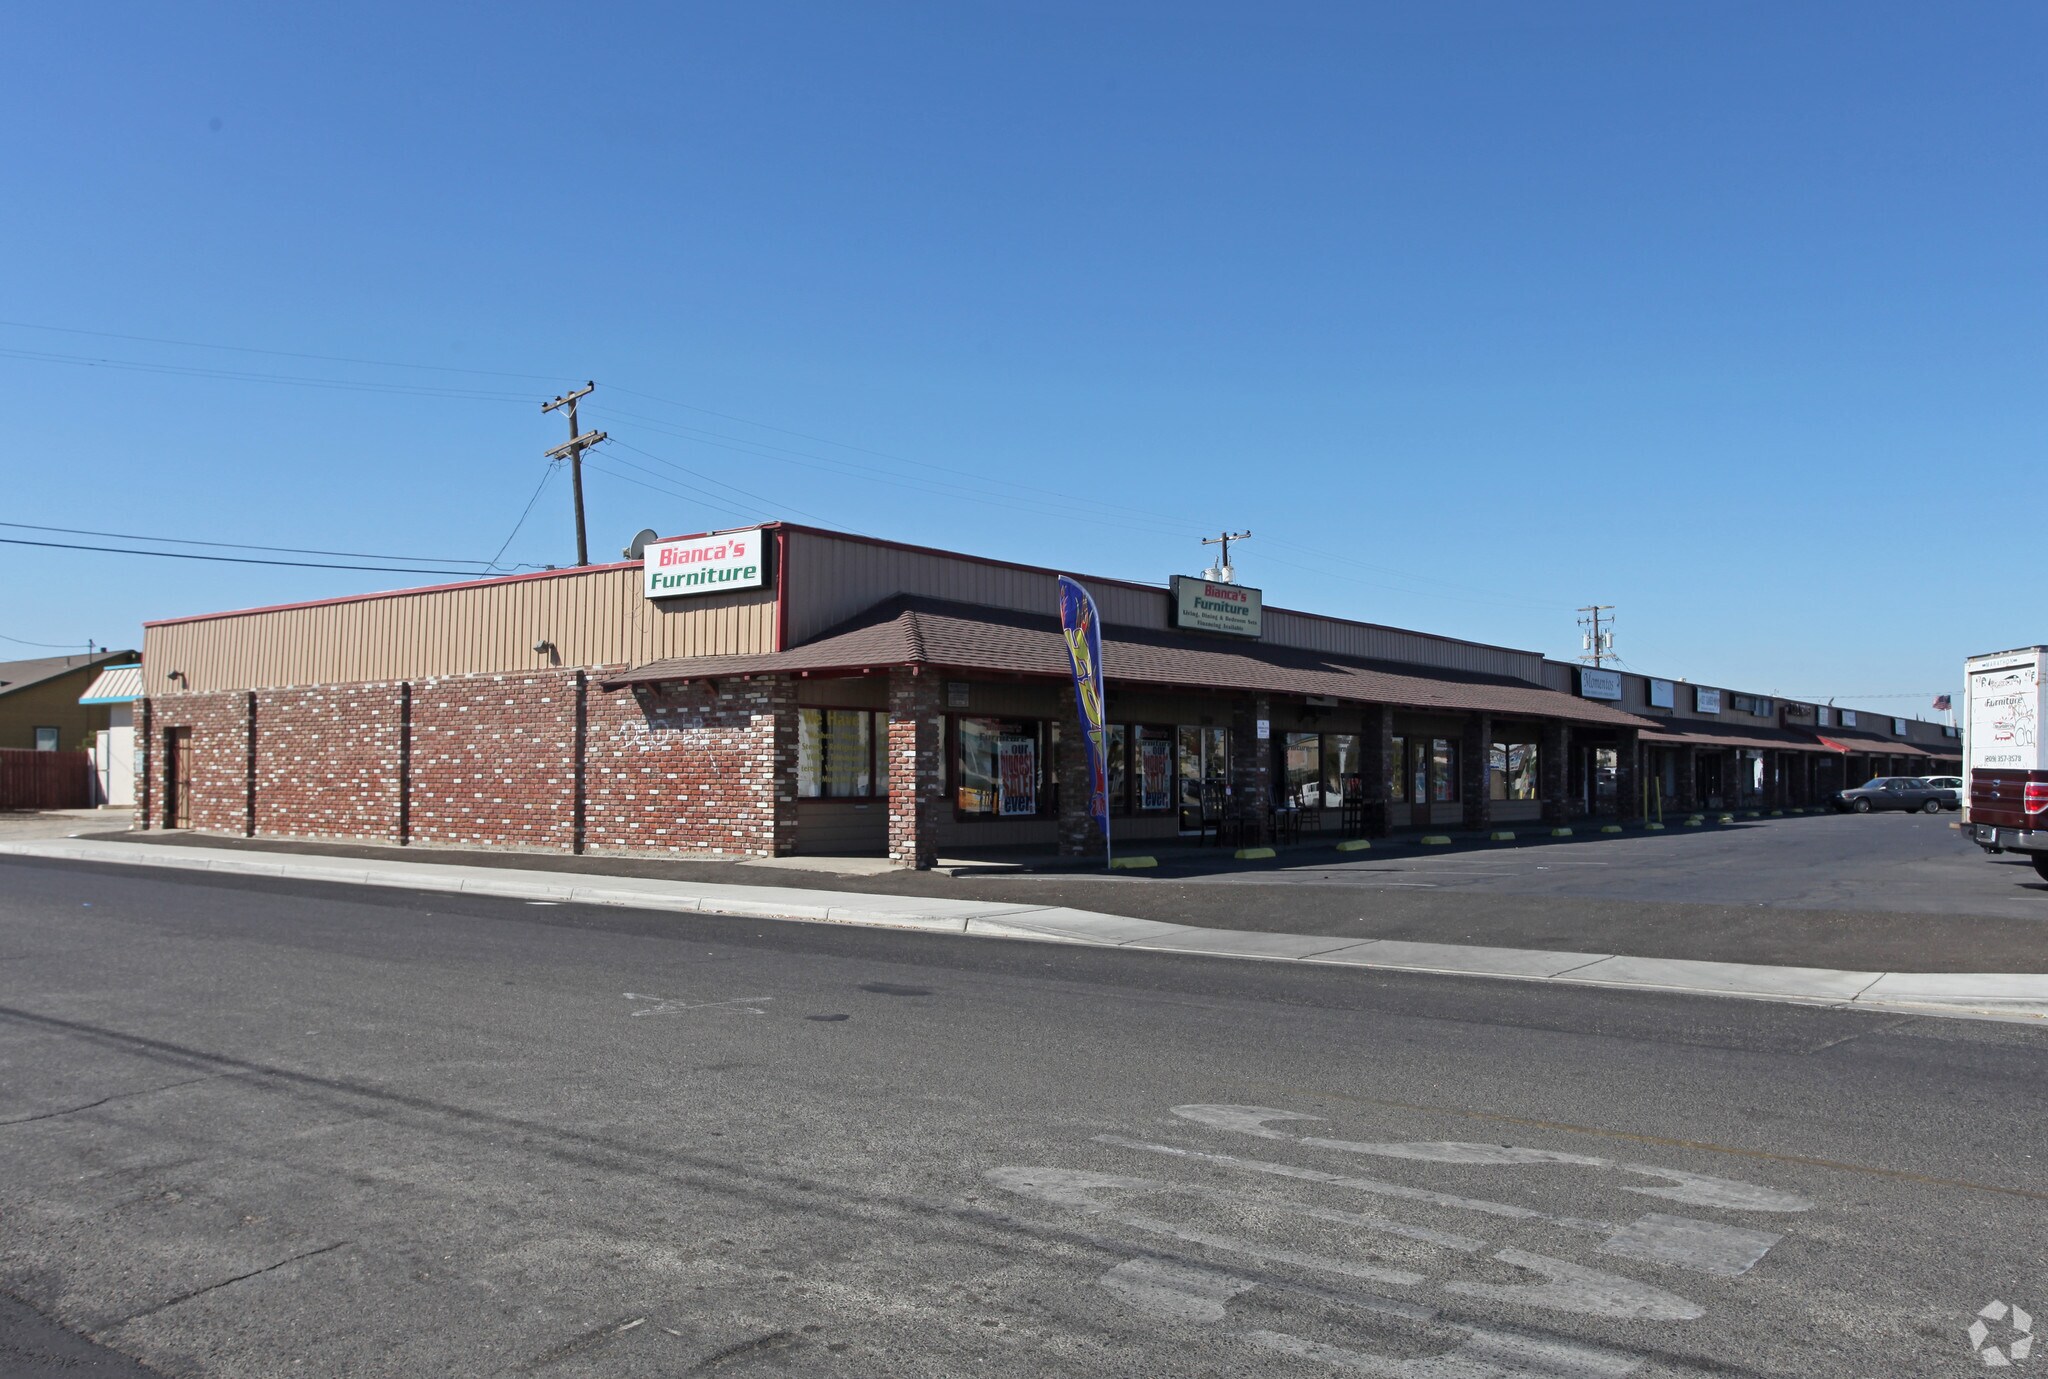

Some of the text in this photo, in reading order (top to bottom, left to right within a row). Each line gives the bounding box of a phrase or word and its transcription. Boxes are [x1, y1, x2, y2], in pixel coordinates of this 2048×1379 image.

[659, 540, 746, 567] Bianca's
[651, 565, 757, 590] Furniture
[1204, 583, 1247, 603] Bianca's
[1194, 596, 1249, 616] Furniture
[1985, 697, 2023, 708] Furniture
[1011, 744, 1028, 755] our
